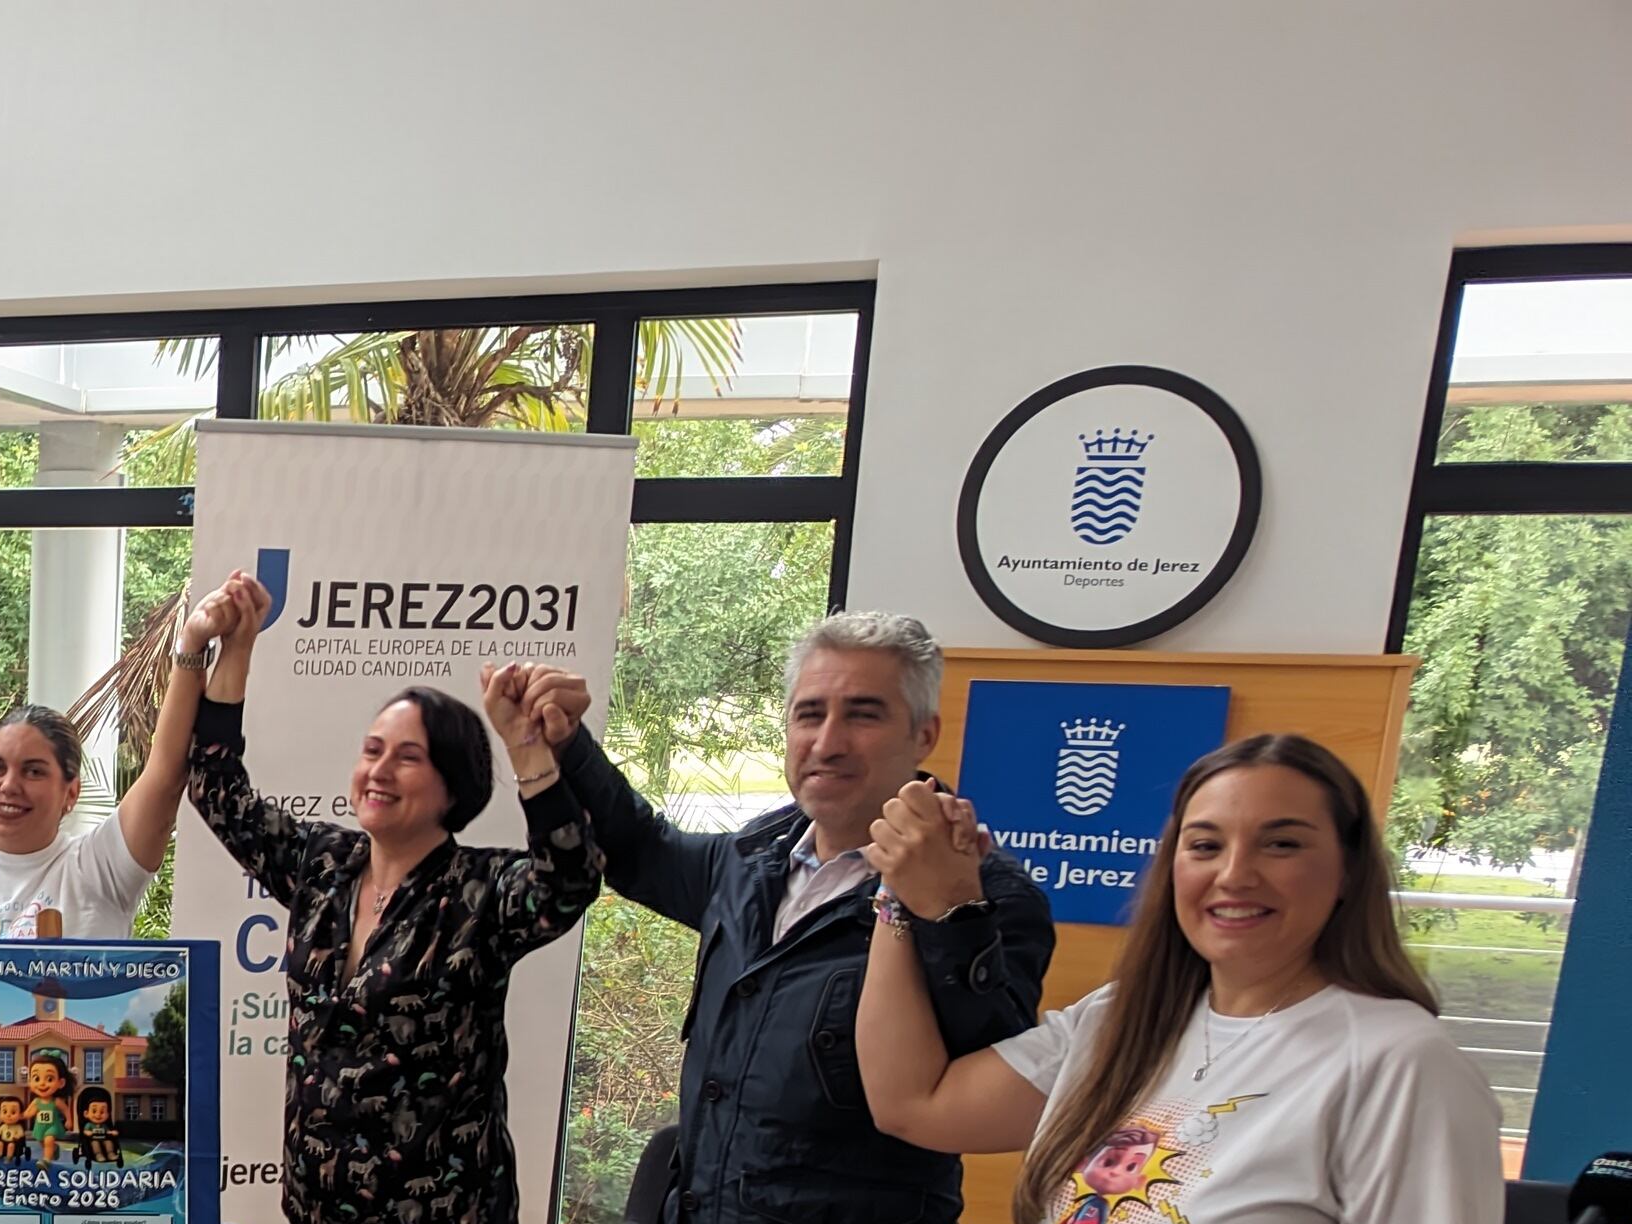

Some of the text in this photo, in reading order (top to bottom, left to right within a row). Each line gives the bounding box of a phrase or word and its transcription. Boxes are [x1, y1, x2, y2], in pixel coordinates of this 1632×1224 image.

[997, 555, 1200, 575] Ayuntamiento de Jerez
[1064, 574, 1125, 589] Deportes
[296, 581, 579, 632] JEREZ2031
[294, 638, 577, 657] CAPITAL EUROPEA DE LA CULTURA
[293, 660, 452, 677] CIUDAD CANDIDATA
[1054, 861, 1136, 889] Jerez
[28, 956, 104, 978] MARTÍN
[109, 962, 121, 978] Y
[126, 962, 180, 979] DIEGO
[229, 1030, 252, 1055] la
[58, 1170, 177, 1190] SOLIDARIA
[3, 1188, 62, 1208] Enero
[68, 1190, 120, 1208] 2026
